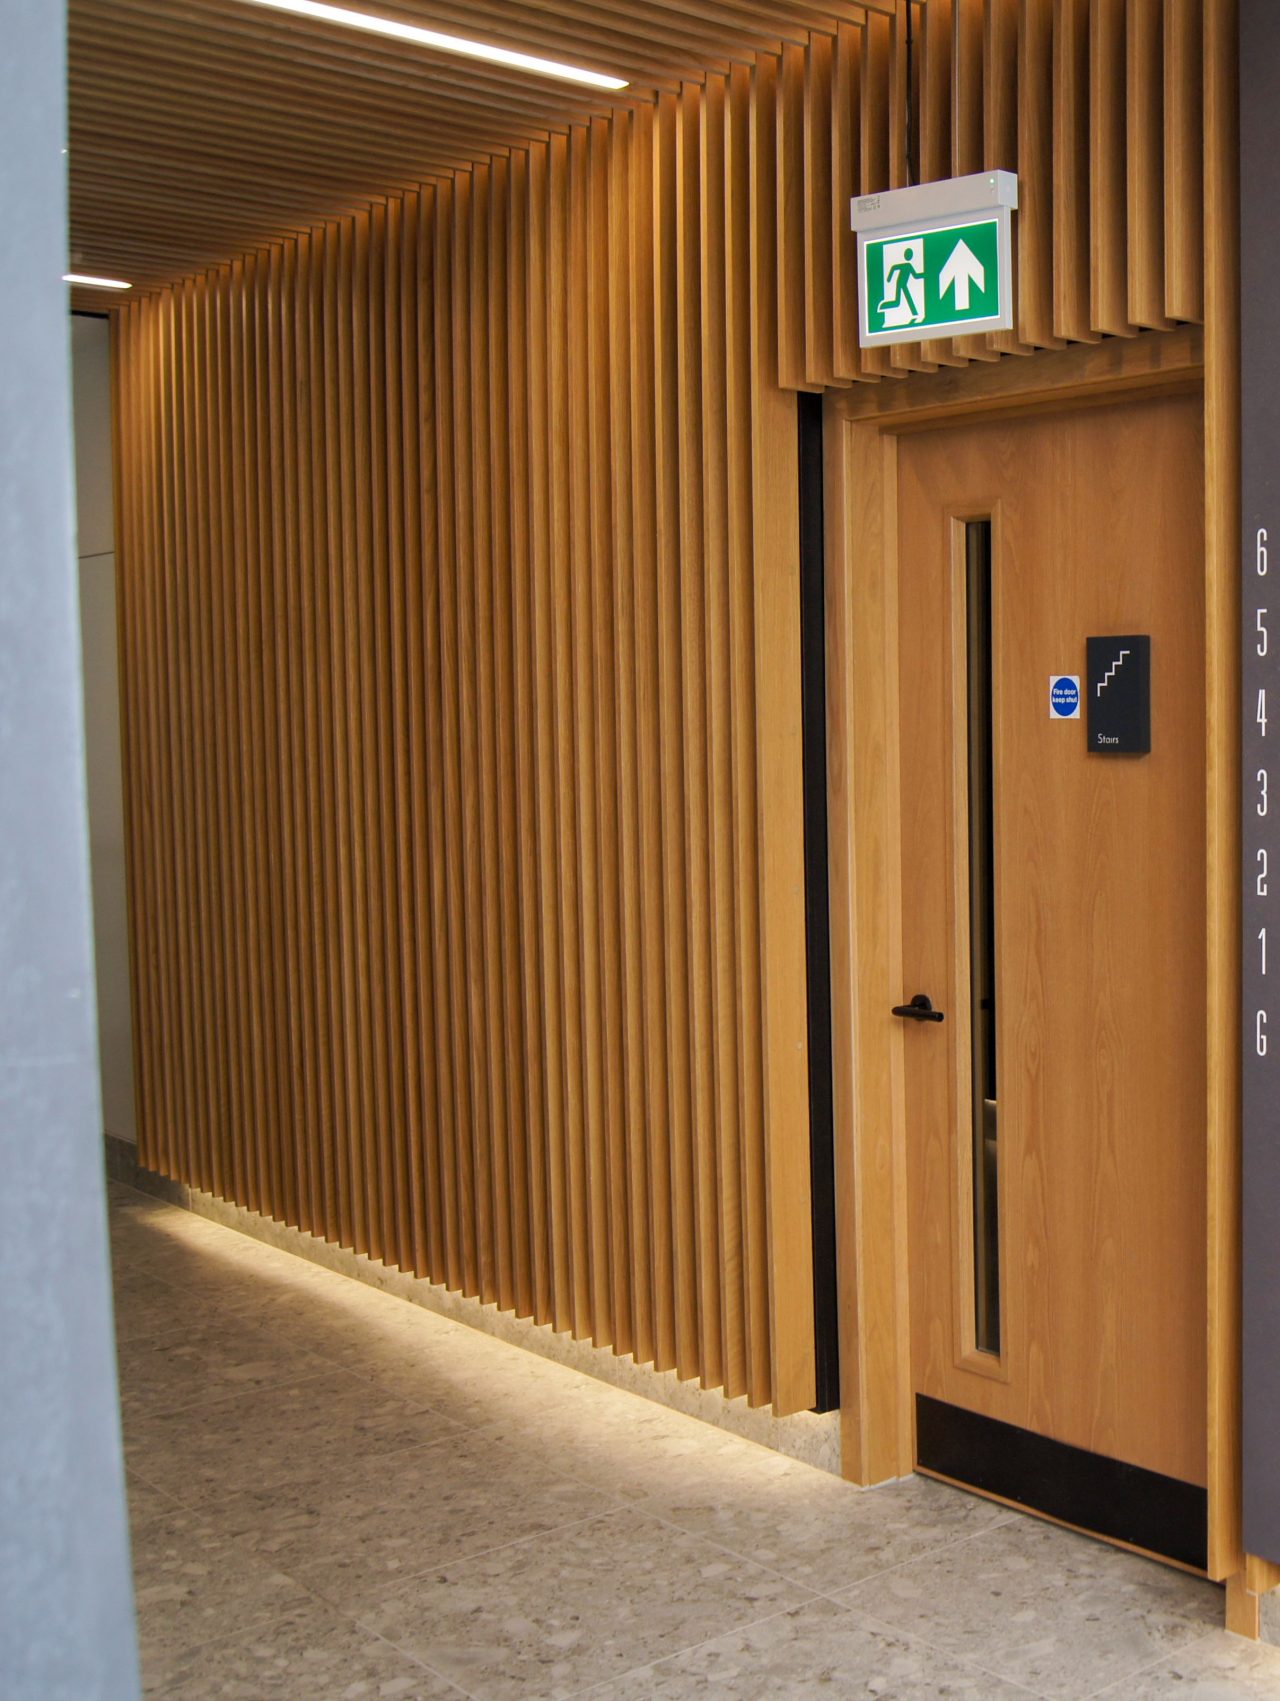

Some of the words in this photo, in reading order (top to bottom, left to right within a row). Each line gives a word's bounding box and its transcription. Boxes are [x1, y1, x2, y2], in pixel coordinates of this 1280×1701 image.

[1257, 528, 1268, 576] 6
[1257, 609, 1268, 656] 5
[1052, 696, 1066, 704] keep
[1257, 689, 1268, 737] 4
[1097, 733, 1119, 744] Stairs
[1257, 769, 1268, 816] 3
[1257, 849, 1268, 896] 2
[1257, 928, 1266, 975] 1
[1256, 1010, 1267, 1056] G
